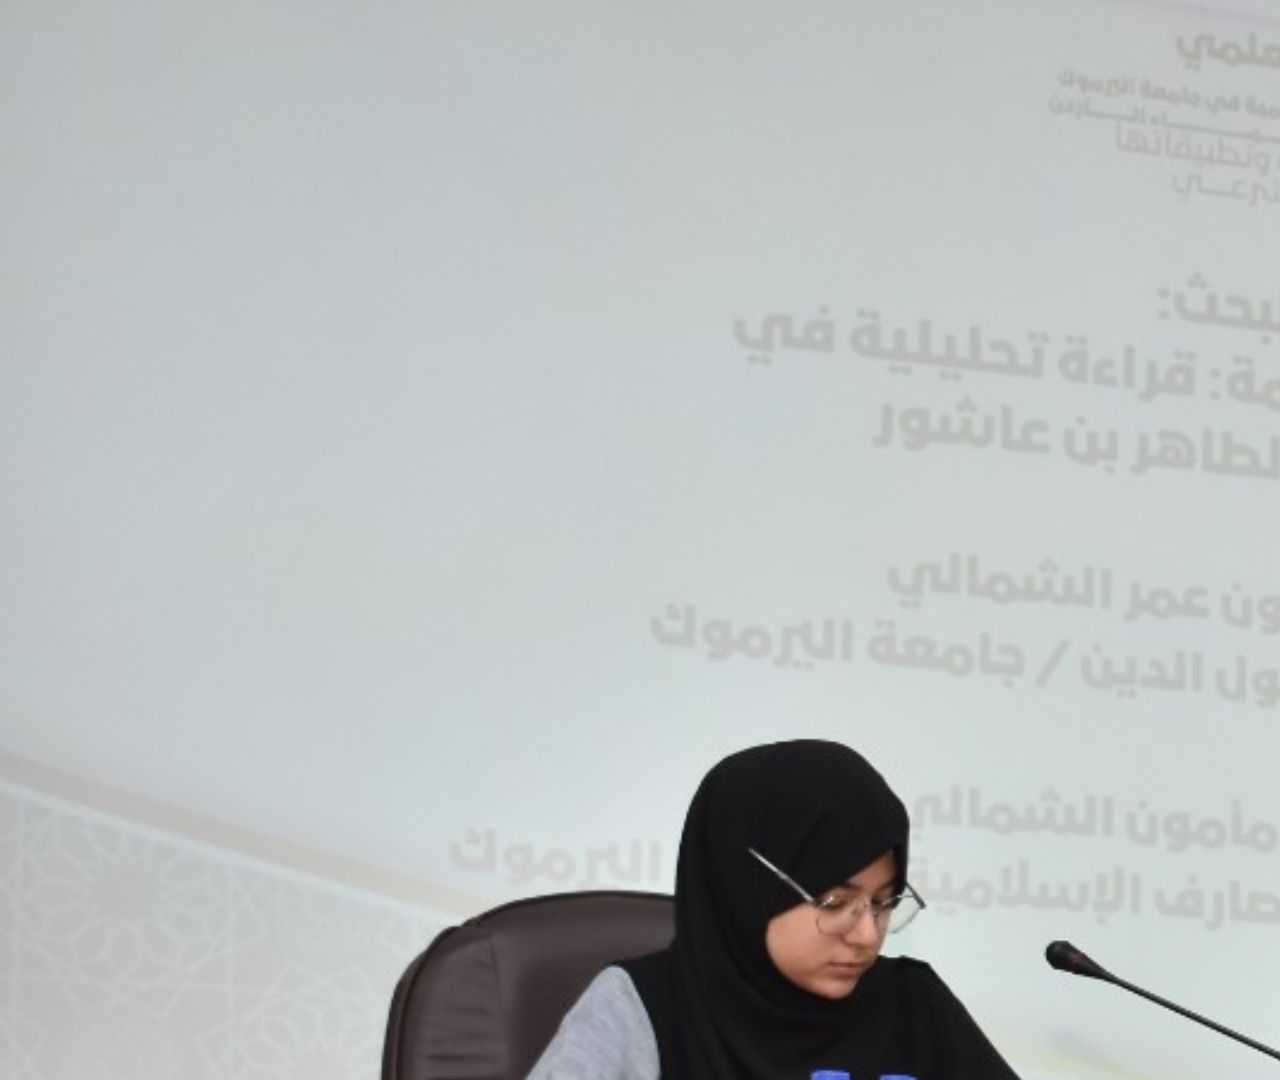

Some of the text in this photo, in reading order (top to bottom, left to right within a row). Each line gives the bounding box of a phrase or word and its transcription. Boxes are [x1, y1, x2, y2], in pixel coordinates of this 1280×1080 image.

[732, 304, 835, 366] في
[848, 308, 1051, 384] تحليلية
[1058, 334, 1198, 403] قراءة
[871, 395, 1051, 455] عاشور
[1063, 416, 1119, 475] بن
[886, 552, 1113, 611] الشمالي
[1121, 581, 1211, 624] عمر
[649, 603, 855, 671] اليرموك
[866, 618, 1026, 690] جامعة
[1079, 642, 1204, 699] الدين
[449, 825, 661, 882] اليرموك
[1125, 796, 1280, 854] مأمون
